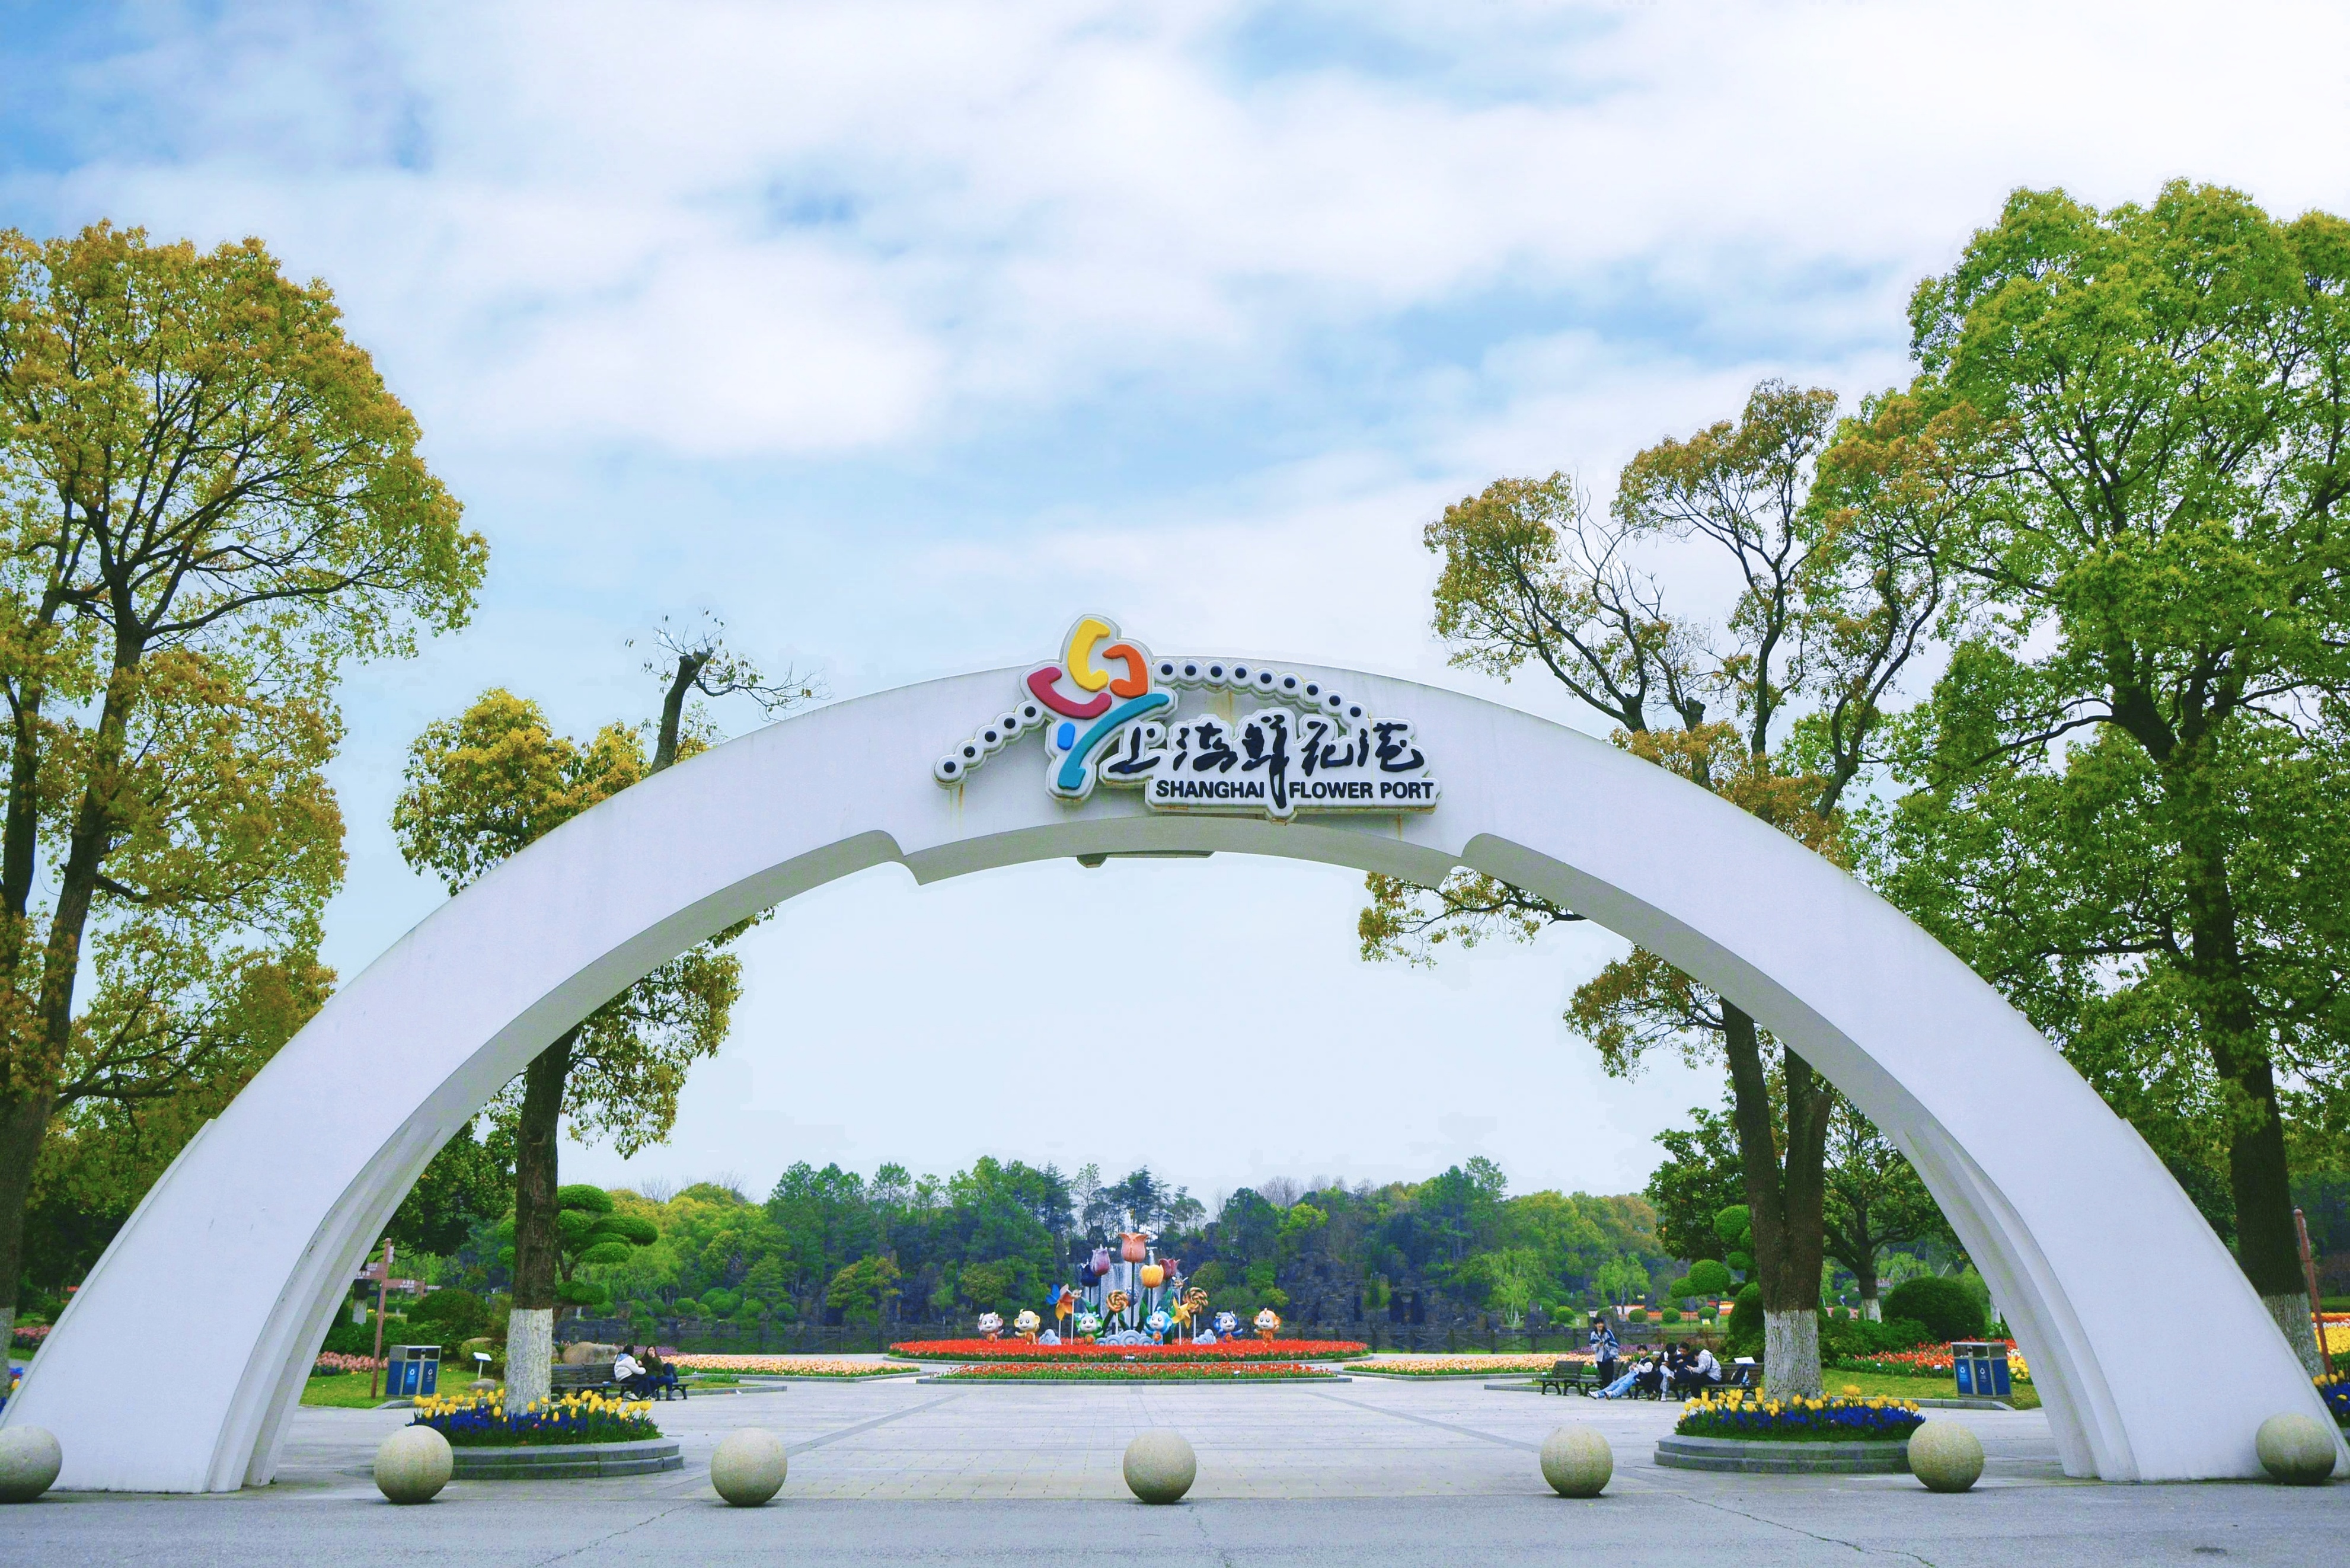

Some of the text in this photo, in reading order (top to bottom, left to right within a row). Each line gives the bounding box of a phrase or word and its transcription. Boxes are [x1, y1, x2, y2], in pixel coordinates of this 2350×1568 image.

[1108, 714, 1425, 809] 上海鲜花港
[1156, 780, 1435, 799] SHANGHAI FLOWER PORT
